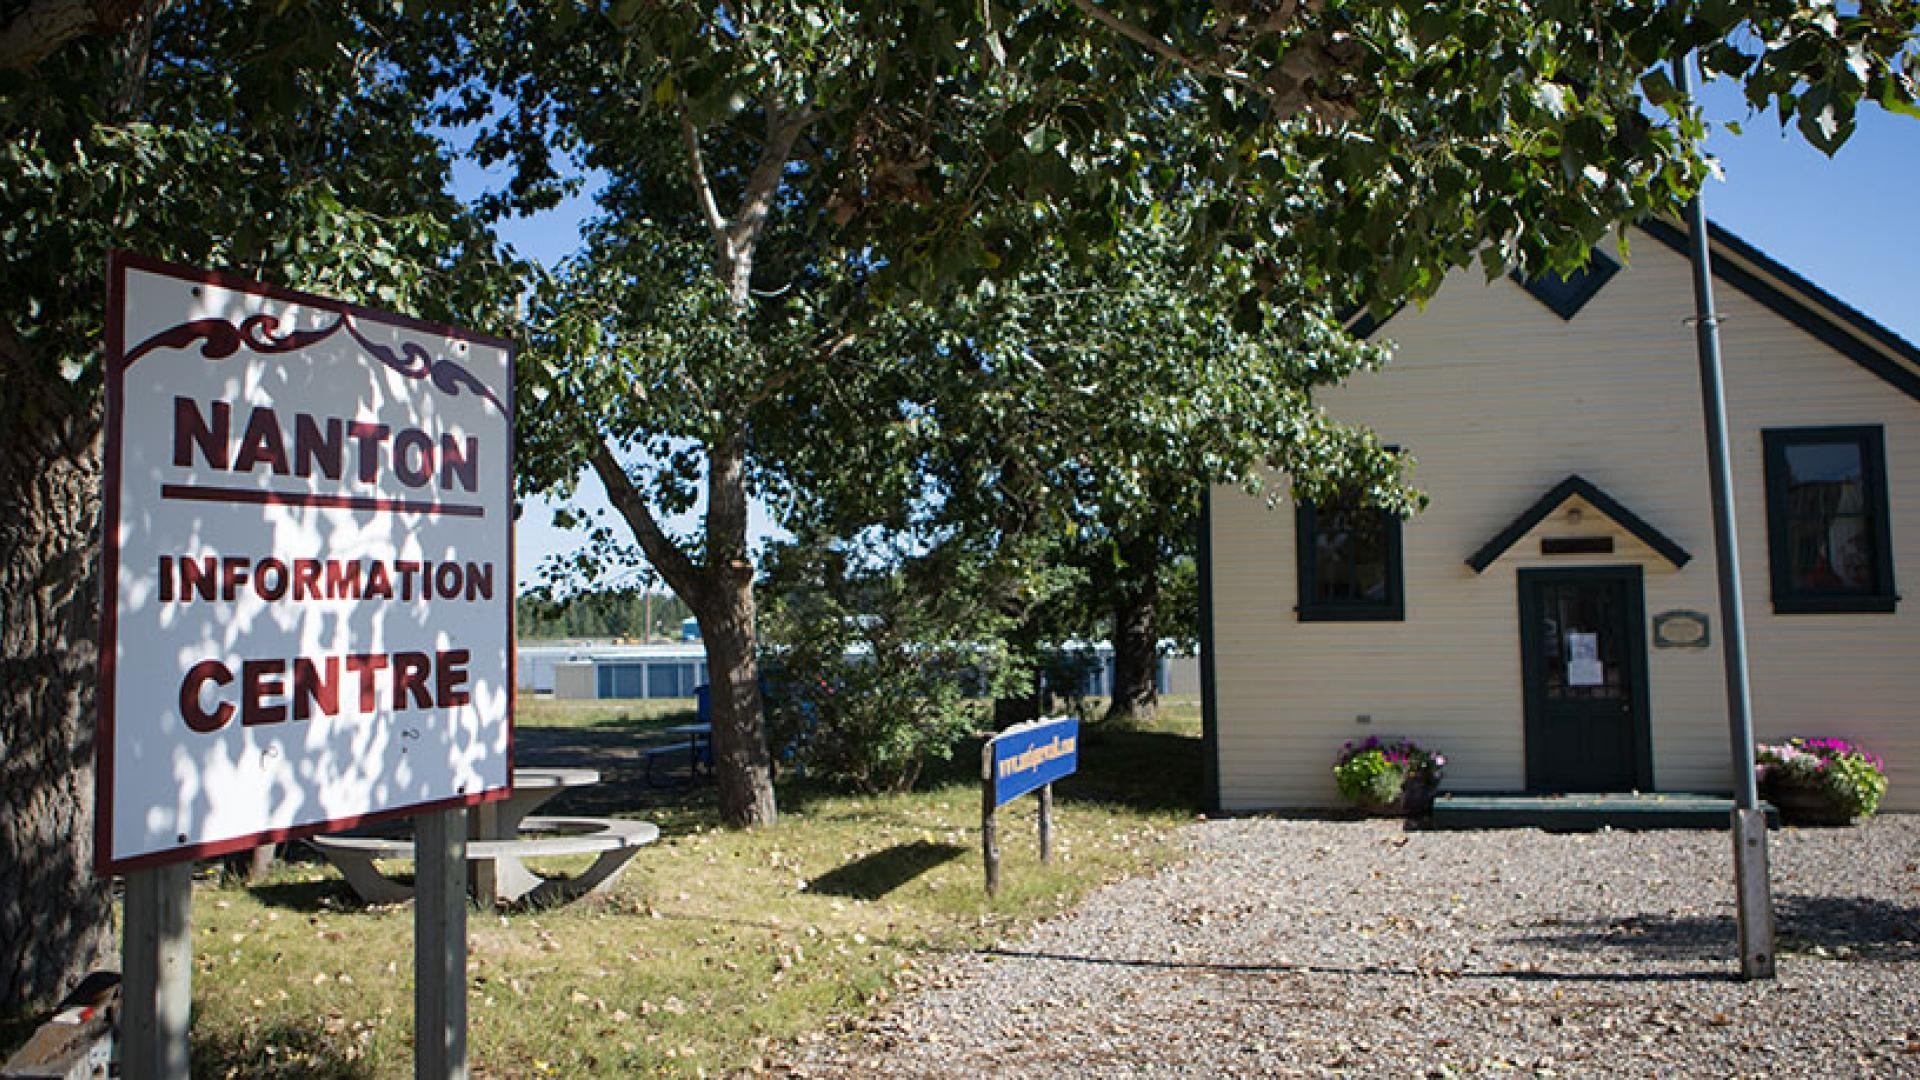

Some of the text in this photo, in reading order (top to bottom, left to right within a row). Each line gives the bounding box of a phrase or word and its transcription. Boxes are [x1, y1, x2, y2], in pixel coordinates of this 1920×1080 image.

[173, 395, 480, 492] NANTON
[158, 556, 494, 603] INFORMATION
[180, 649, 472, 733] CENTRE
